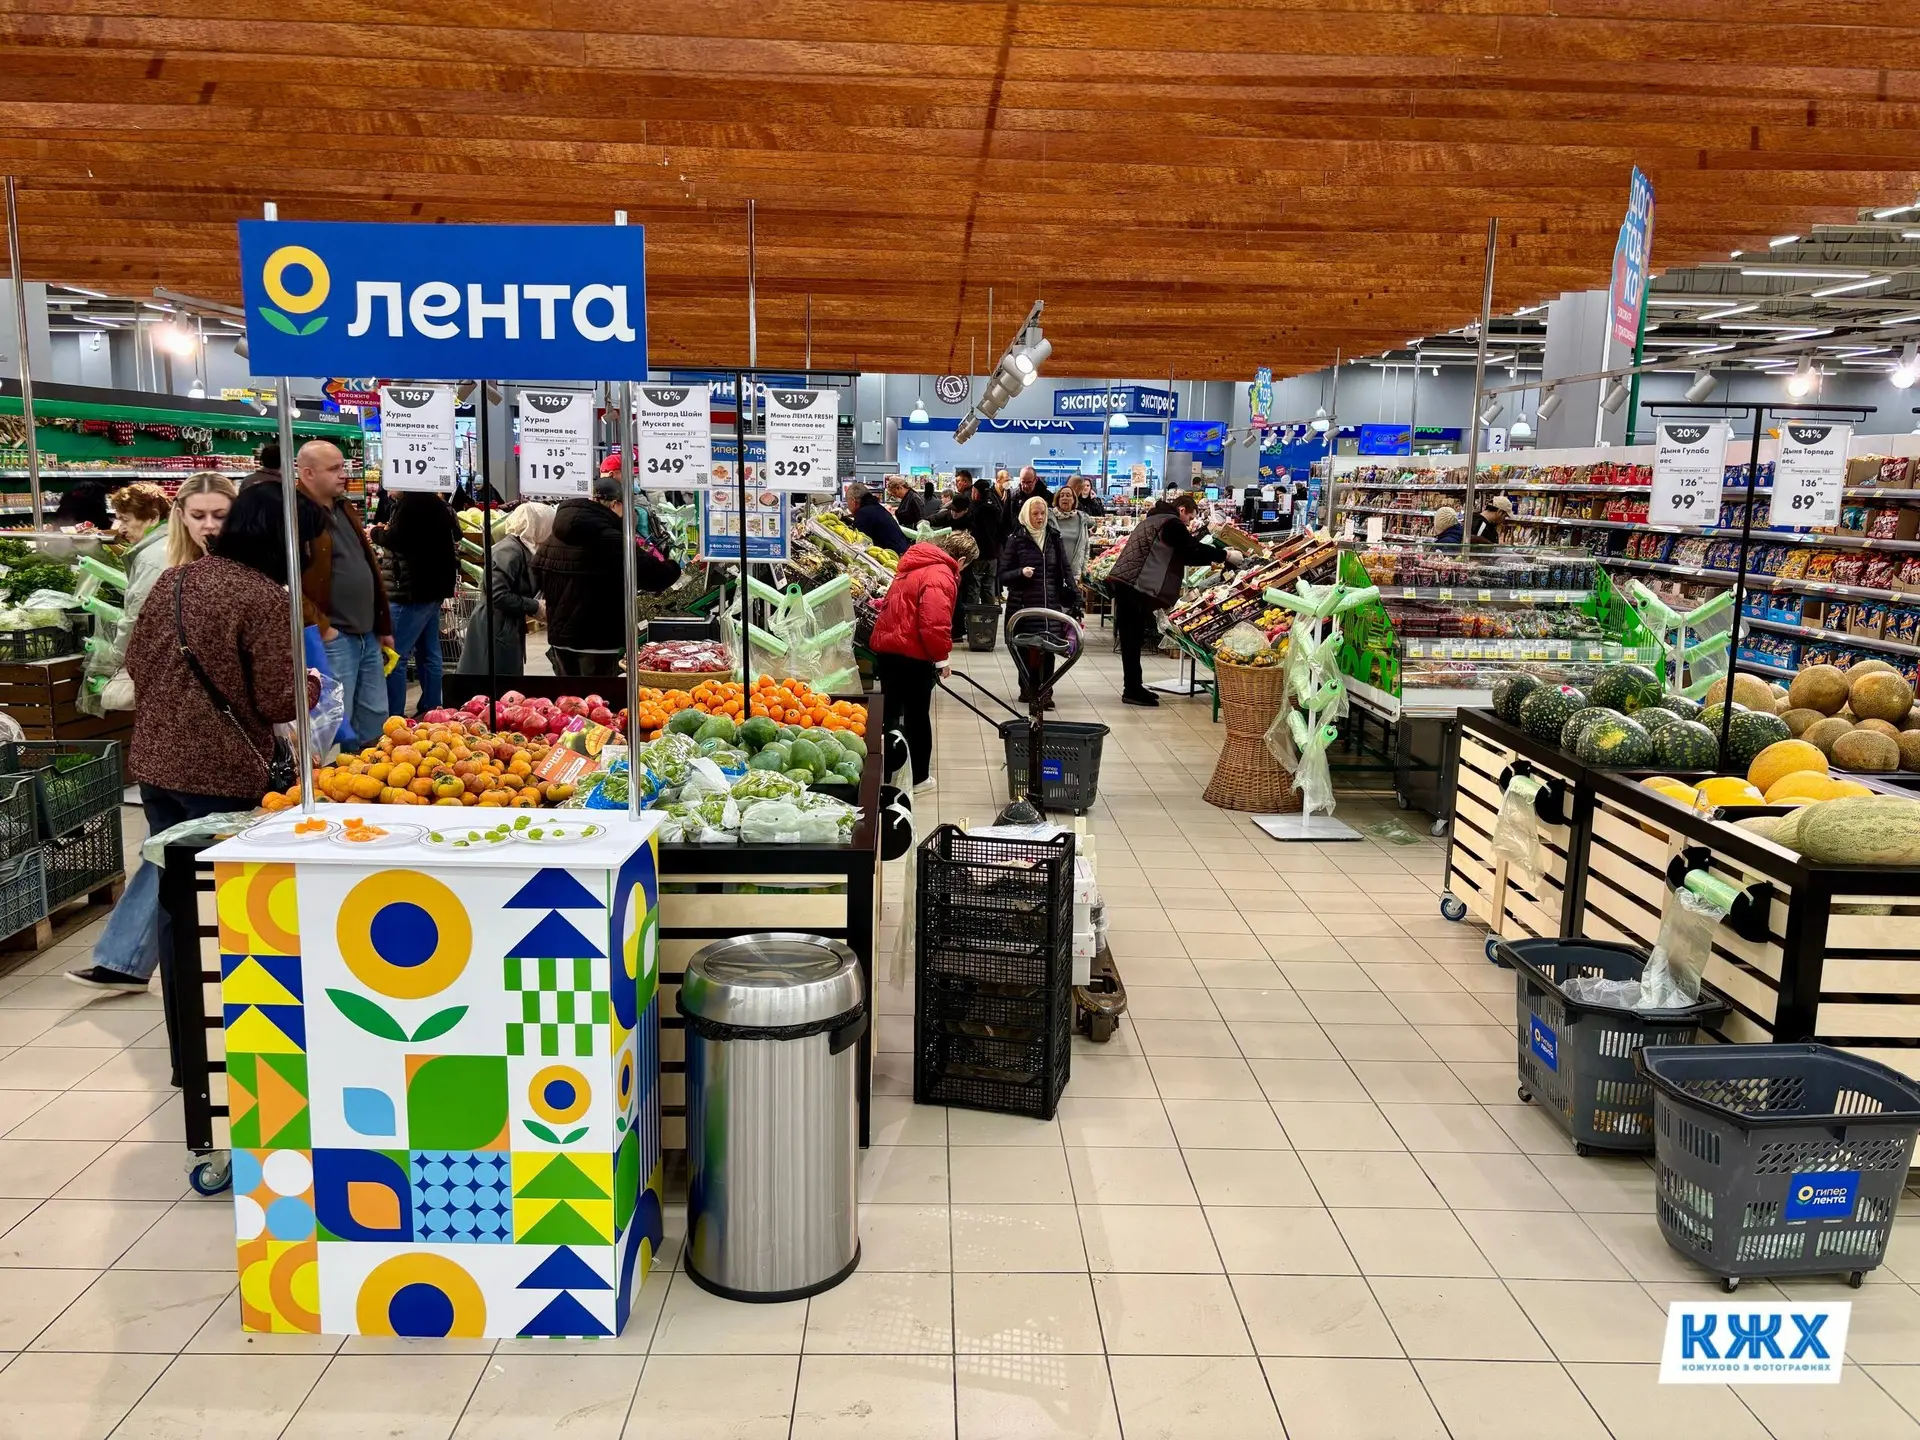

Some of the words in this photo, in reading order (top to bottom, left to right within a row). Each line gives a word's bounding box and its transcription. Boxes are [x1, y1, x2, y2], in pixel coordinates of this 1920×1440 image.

[347, 280, 636, 342] лента
[651, 391, 681, 401] -16%
[780, 393, 809, 404] -21%
[386, 411, 411, 419] Хурма
[641, 410, 679, 419] Виноград
[524, 416, 550, 424] Хурма
[642, 420, 670, 428] Мускат
[1672, 428, 1700, 438] -20%
[1794, 429, 1822, 438] -34%
[1494, 434, 1502, 445] 2
[409, 444, 427, 452] 315
[665, 442, 682, 450] 421
[793, 445, 810, 454] 421
[1682, 447, 1710, 455] Гулаба
[547, 449, 565, 457] 315
[1804, 448, 1834, 456] Торпеда
[393, 459, 427, 475] 119
[647, 458, 684, 474] 349
[774, 460, 811, 476] 329
[531, 464, 565, 480] 119
[1801, 479, 1817, 487] 136
[1671, 494, 1695, 509] 99
[1791, 494, 1815, 510] 89
[540, 747, 567, 776] манго
[1815, 1187, 1848, 1198] гипер
[1812, 1195, 1847, 1205] лента
